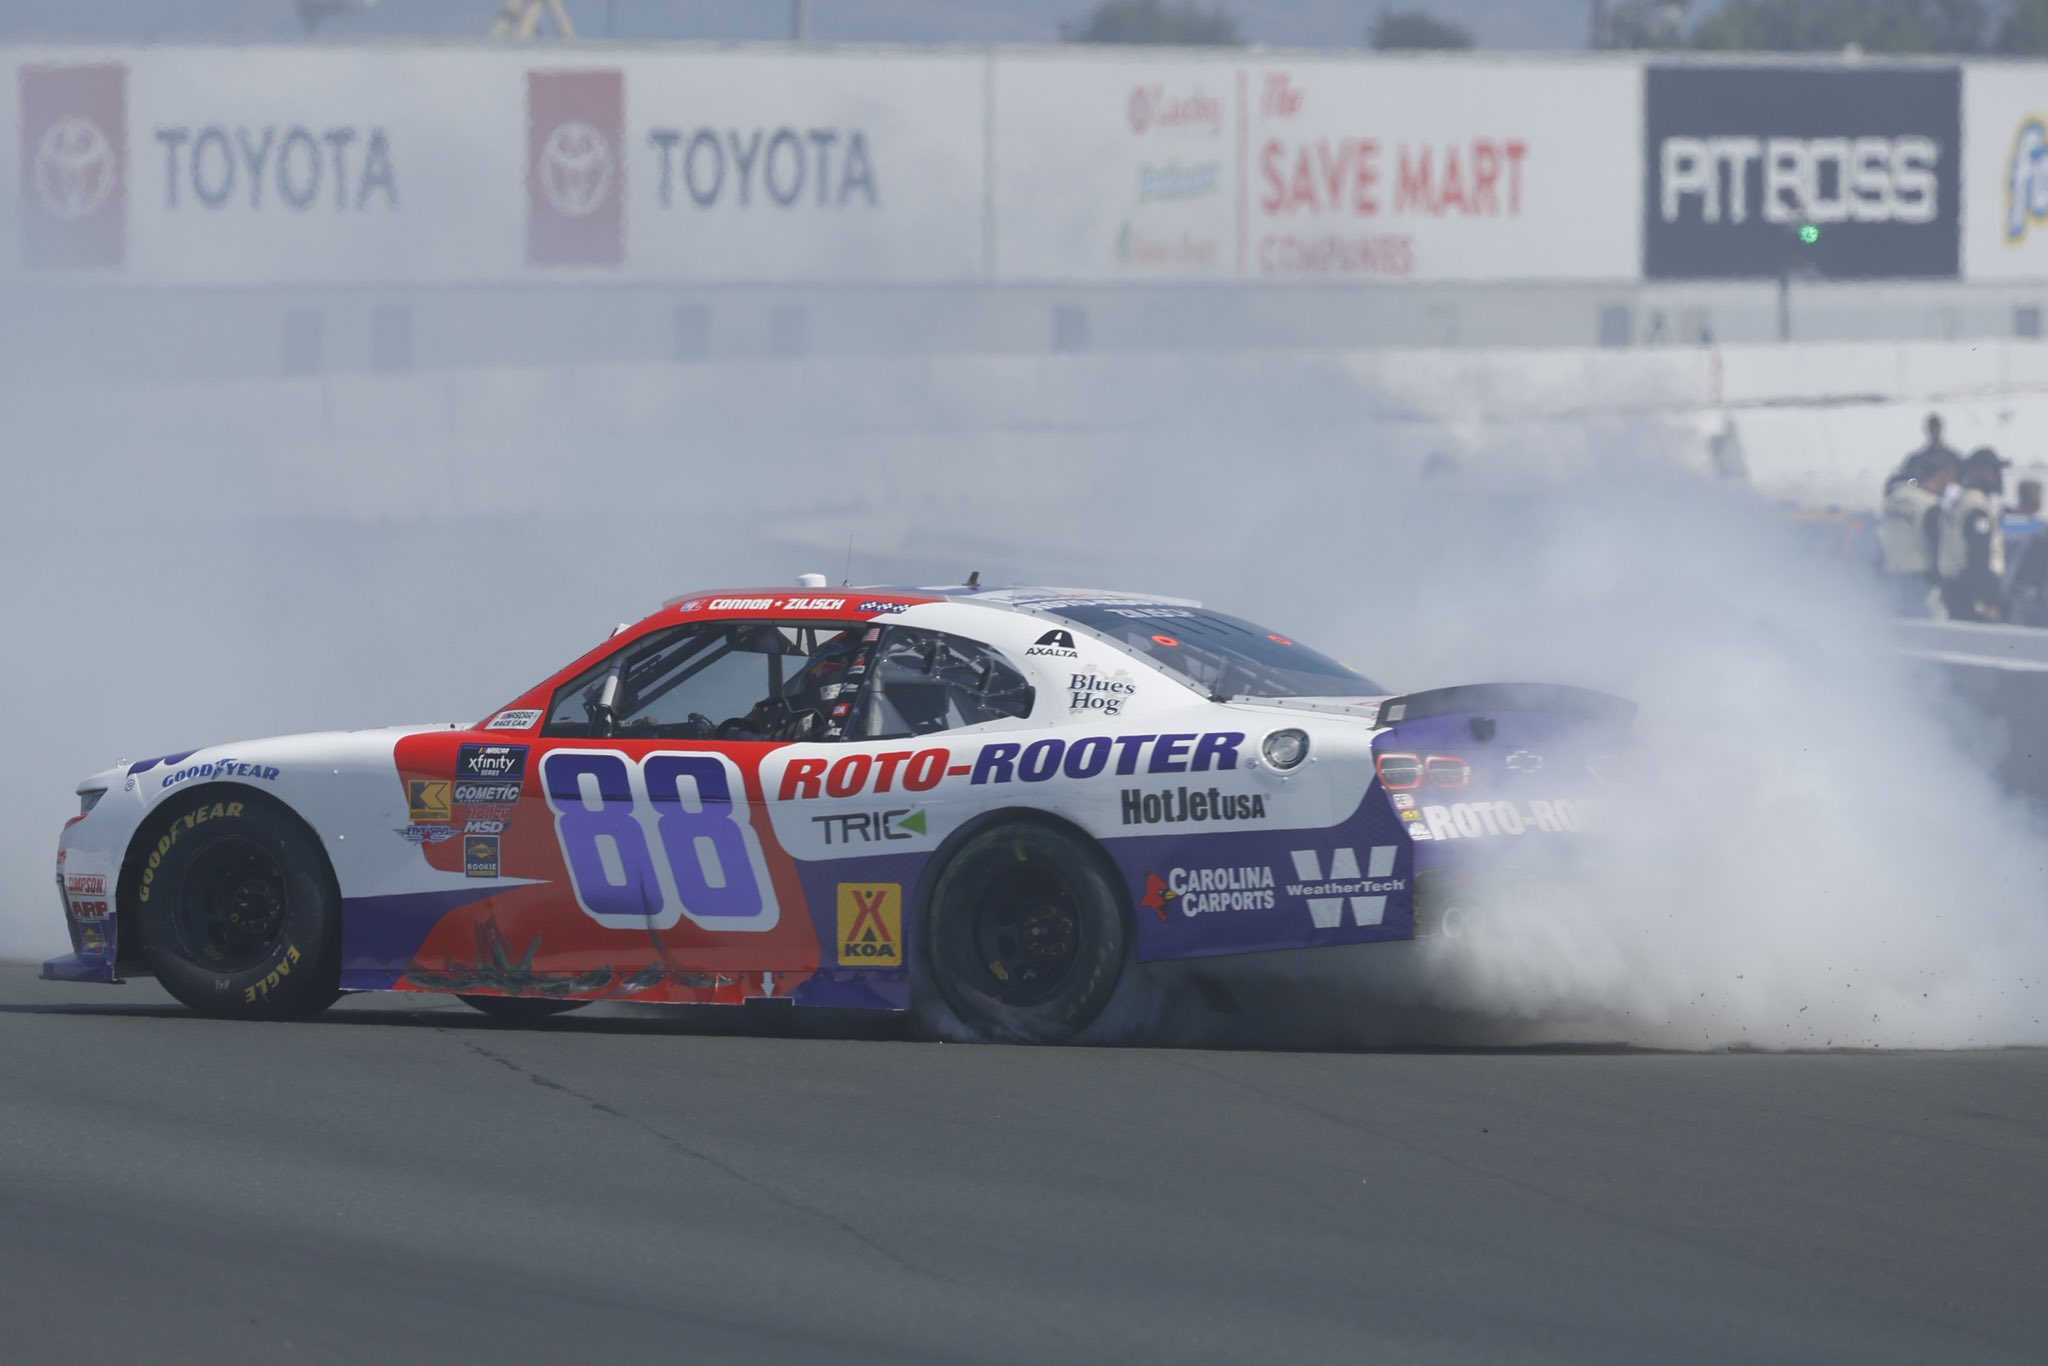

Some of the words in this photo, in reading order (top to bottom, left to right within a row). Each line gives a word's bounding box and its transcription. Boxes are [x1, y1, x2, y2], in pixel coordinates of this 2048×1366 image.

[154, 126, 398, 210] TOYOTA
[649, 127, 880, 207] TOYOTA
[1261, 138, 1380, 217] SAVE
[1396, 140, 1527, 217] MART
[1661, 136, 1761, 223] PIT
[1763, 135, 1938, 223] BOSS
[708, 599, 773, 610] CONNOR
[783, 598, 845, 610] ZILISCH
[1025, 647, 1078, 658] AXALTA
[1068, 673, 1135, 695] Blues
[1070, 692, 1121, 715] Hog
[468, 754, 515, 773] xfinity
[777, 731, 1246, 801] ROTO-ROOTER
[455, 785, 519, 800] COMETIC
[464, 821, 504, 833] MSD
[1422, 799, 1588, 841] ROTO-RO
[541, 751, 772, 925] 88
[67, 875, 104, 894] SIMPSON
[1168, 866, 1275, 896] CAROLINA
[1286, 879, 1404, 896] WeatherTech
[72, 901, 108, 916] ARP
[1181, 891, 1275, 918] CARPORTS
[844, 943, 896, 957] KOA
[244, 944, 301, 1003] EAGLE
